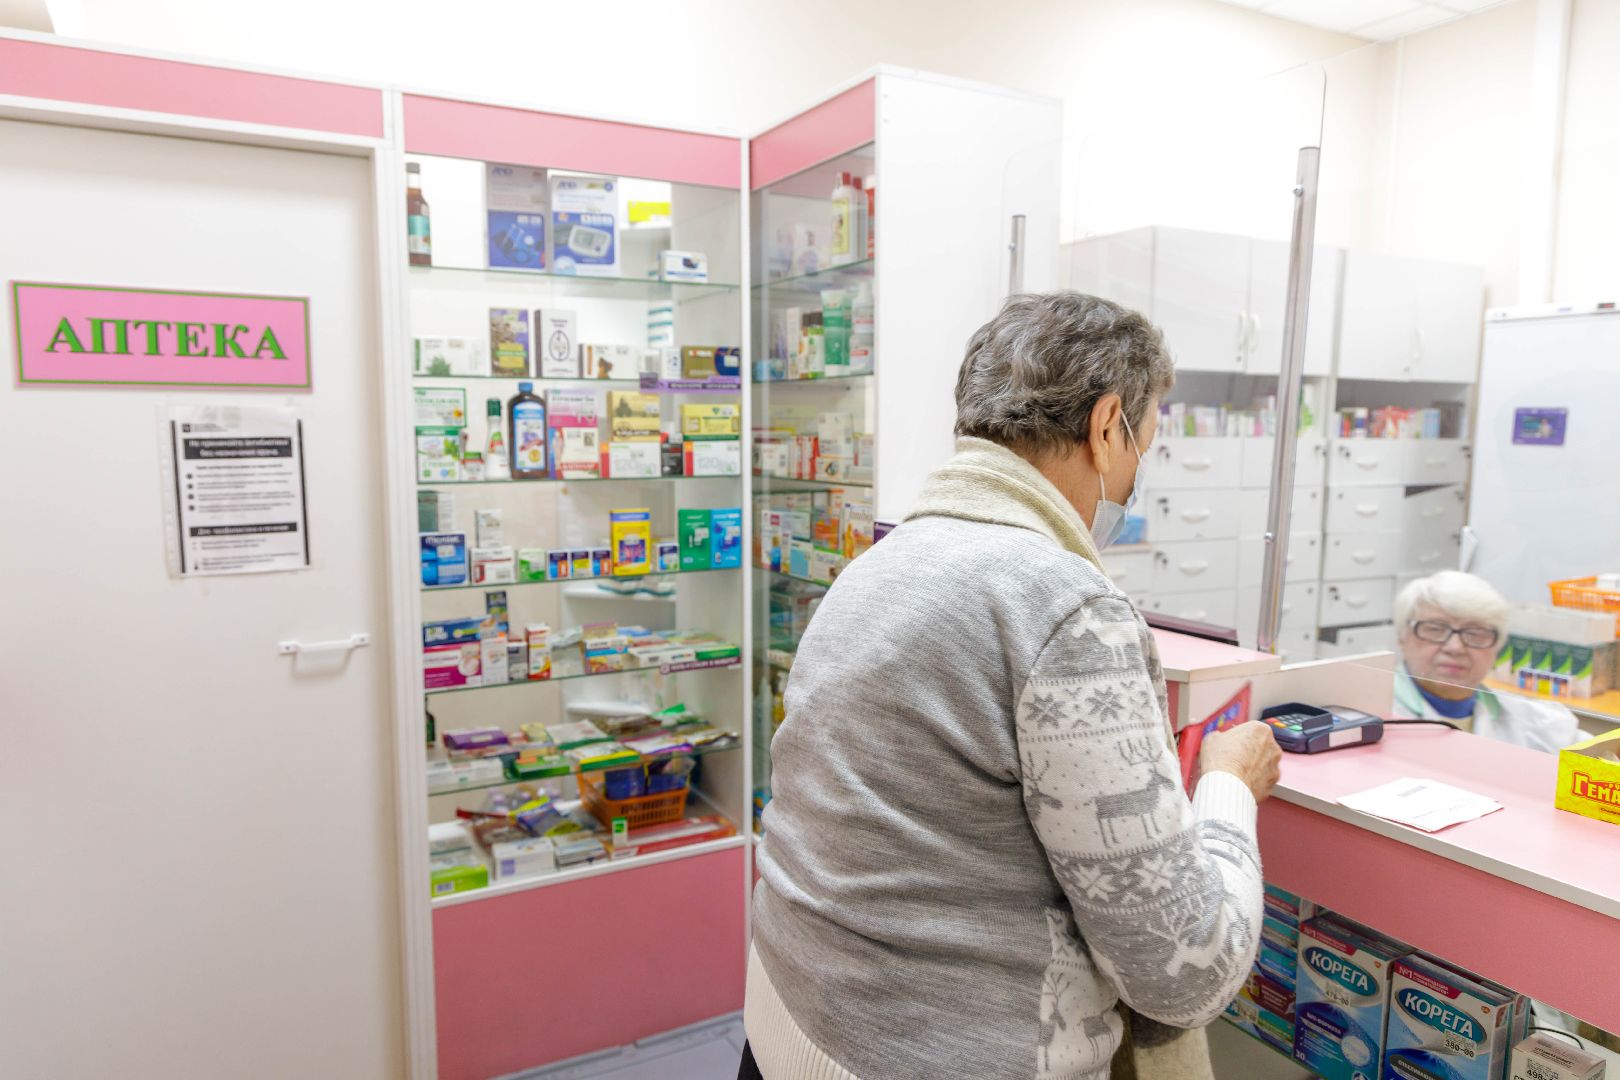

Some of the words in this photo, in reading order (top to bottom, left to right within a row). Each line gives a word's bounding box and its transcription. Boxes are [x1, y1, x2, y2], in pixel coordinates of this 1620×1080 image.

[45, 316, 289, 360] АПТЕКА
[1574, 776, 1620, 804] ГЕМА
[1306, 951, 1368, 991] КОРЕГА
[1400, 966, 1413, 979] №1
[1405, 992, 1473, 1038] КОРЕГА
